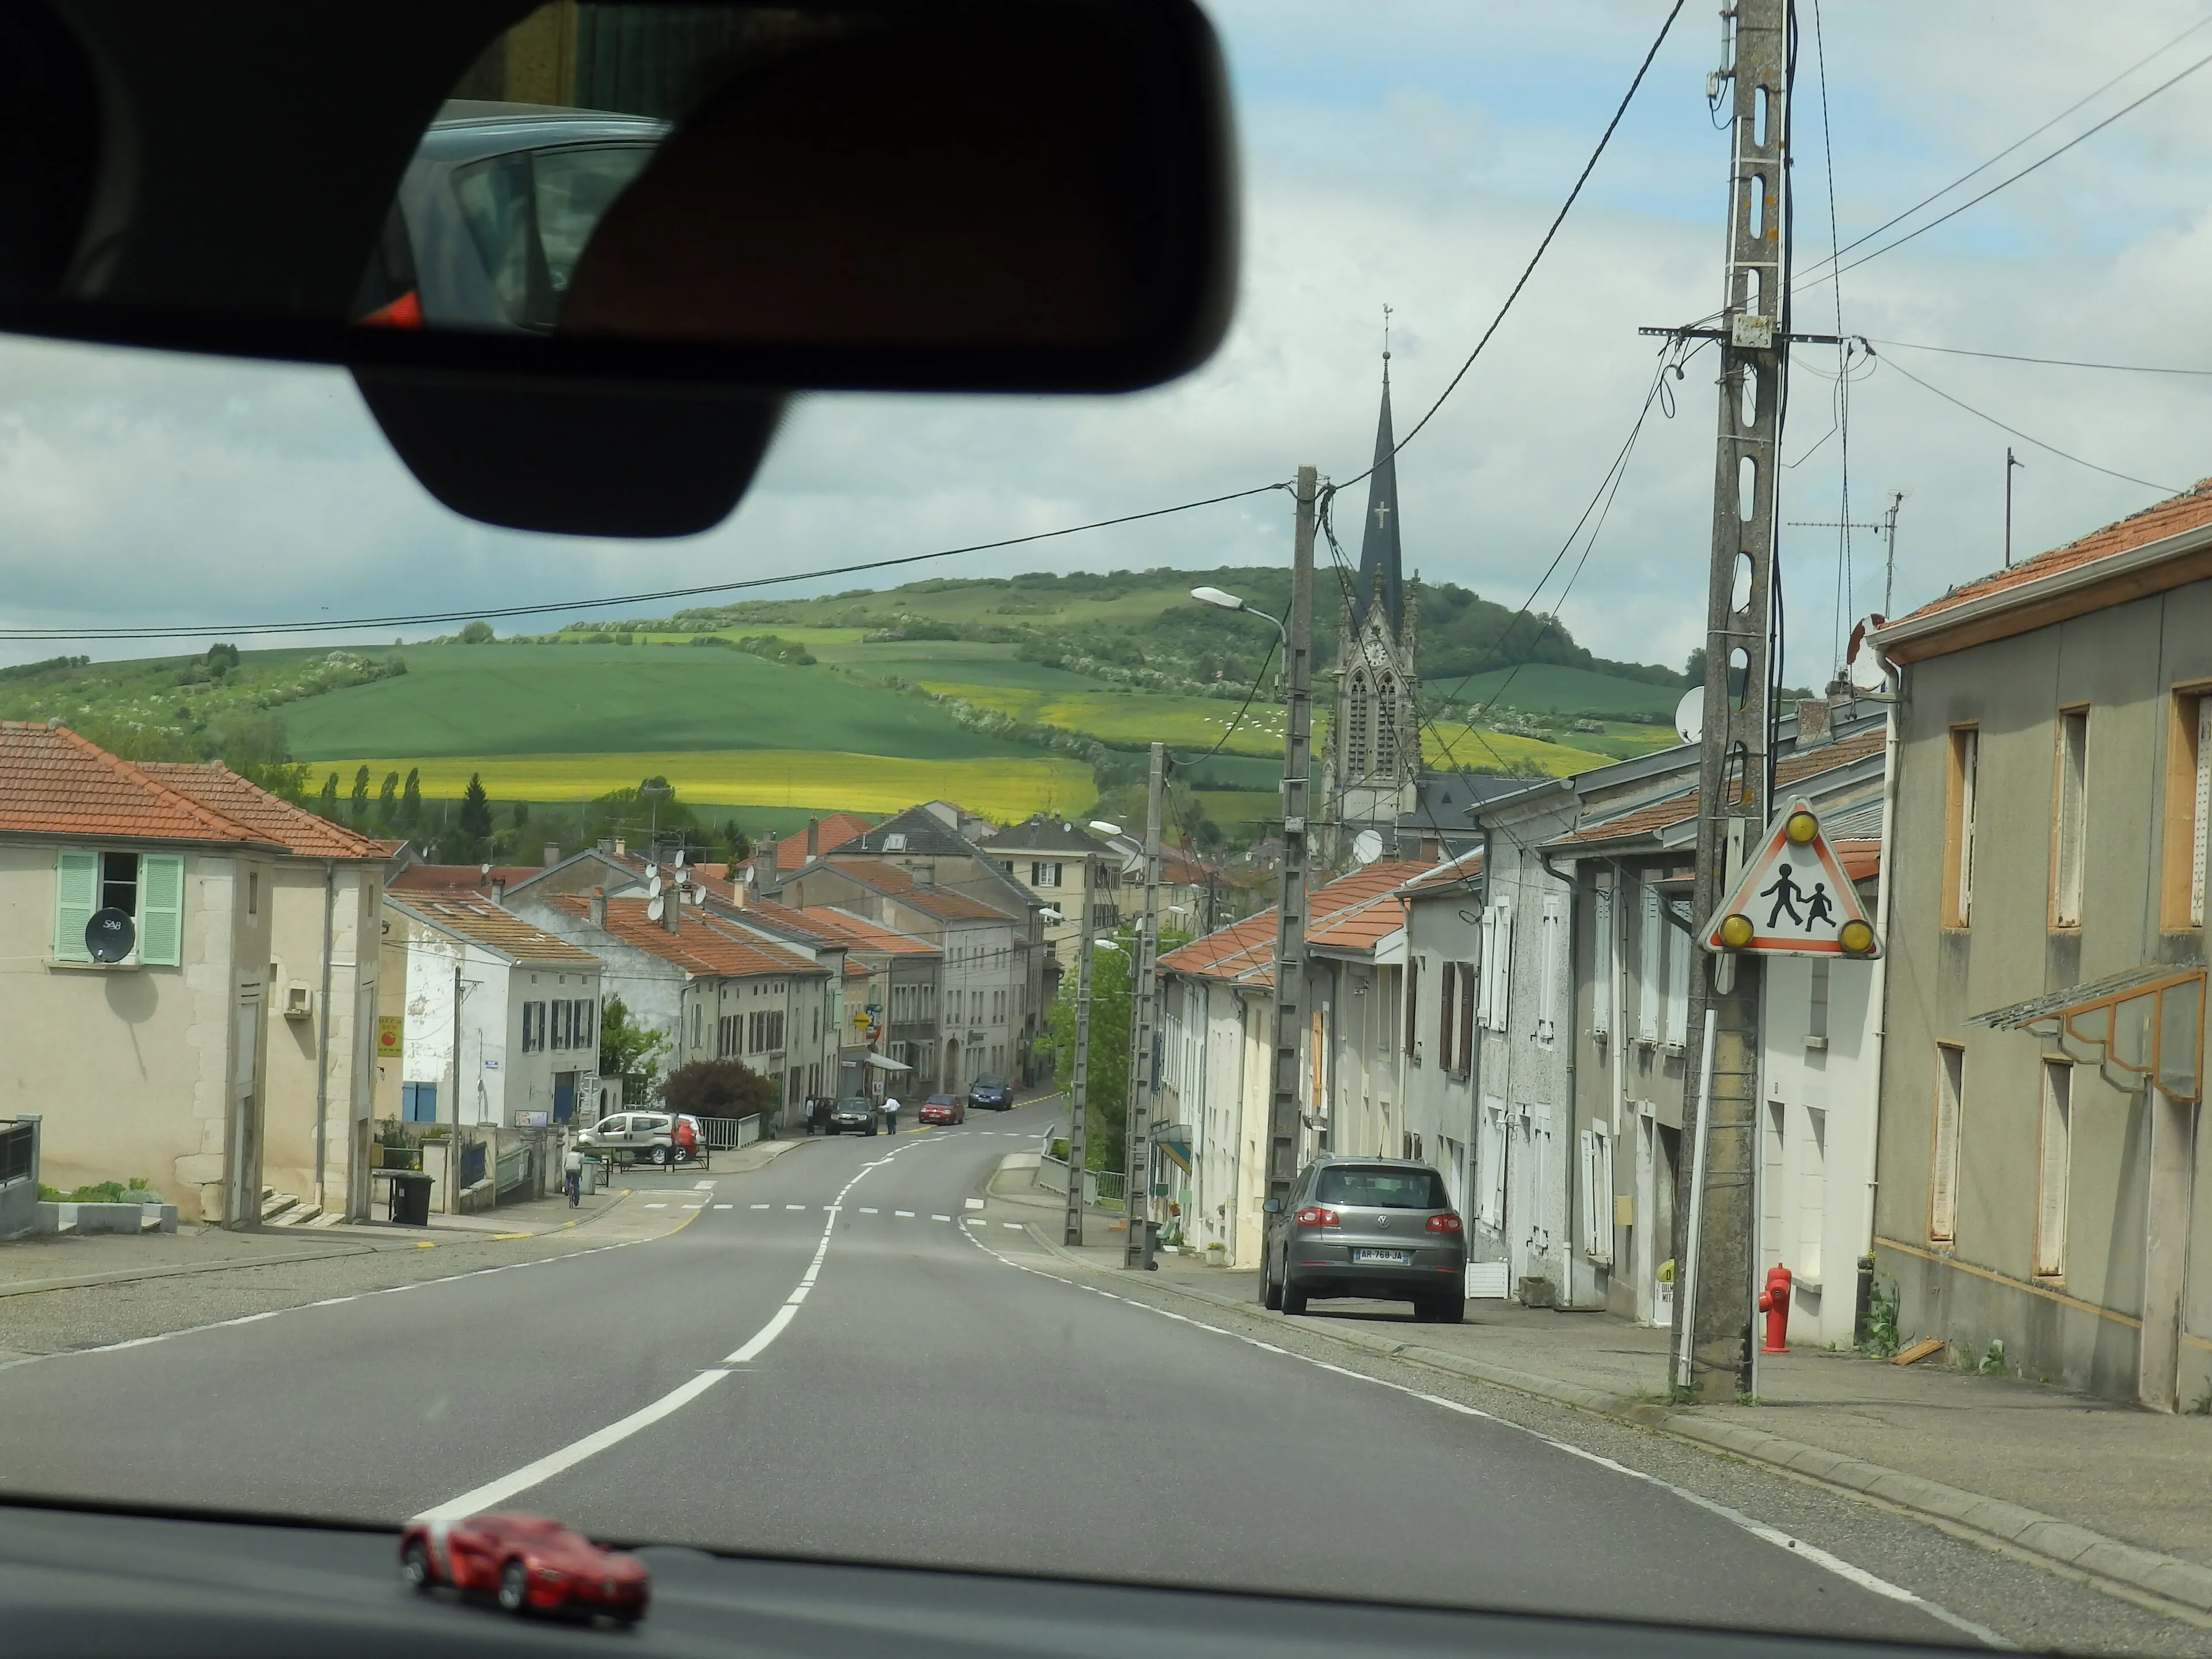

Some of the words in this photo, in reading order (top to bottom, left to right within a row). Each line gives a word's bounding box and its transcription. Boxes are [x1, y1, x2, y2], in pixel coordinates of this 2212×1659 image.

[103, 920, 121, 930] SAB
[1362, 1250, 1402, 1260] AR-768-JA
[1666, 1270, 1671, 1280] D
[1662, 1293, 1673, 1302] MET
